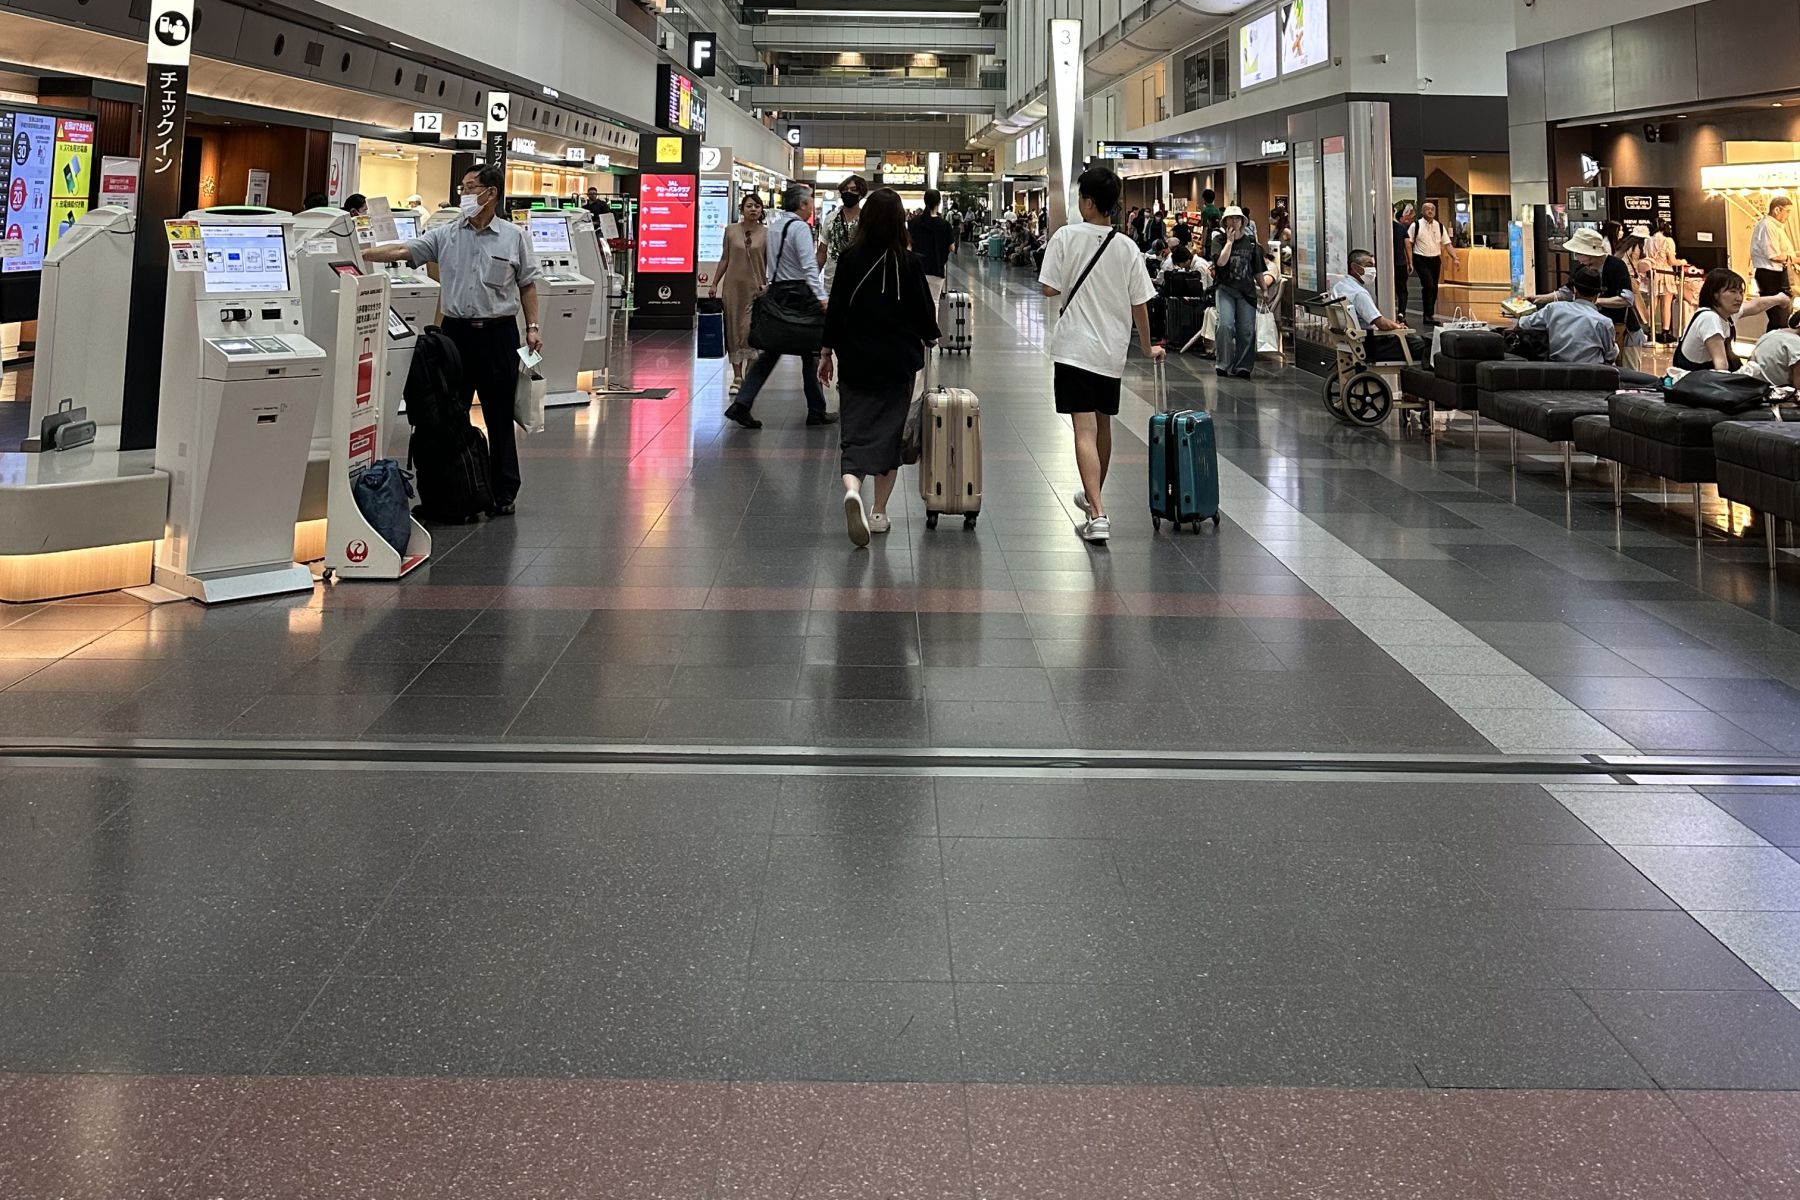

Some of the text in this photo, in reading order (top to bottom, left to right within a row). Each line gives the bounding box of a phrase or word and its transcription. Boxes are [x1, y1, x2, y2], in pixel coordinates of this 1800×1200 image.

[1061, 29, 1072, 46] 3
[694, 40, 712, 69] F
[154, 71, 179, 174] チェックイン
[418, 115, 438, 130] 12
[462, 124, 480, 138] 13
[787, 128, 801, 145] G
[17, 145, 27, 159] 30
[570, 149, 582, 159] 14
[701, 151, 716, 167] 12
[13, 191, 23, 204] 20
